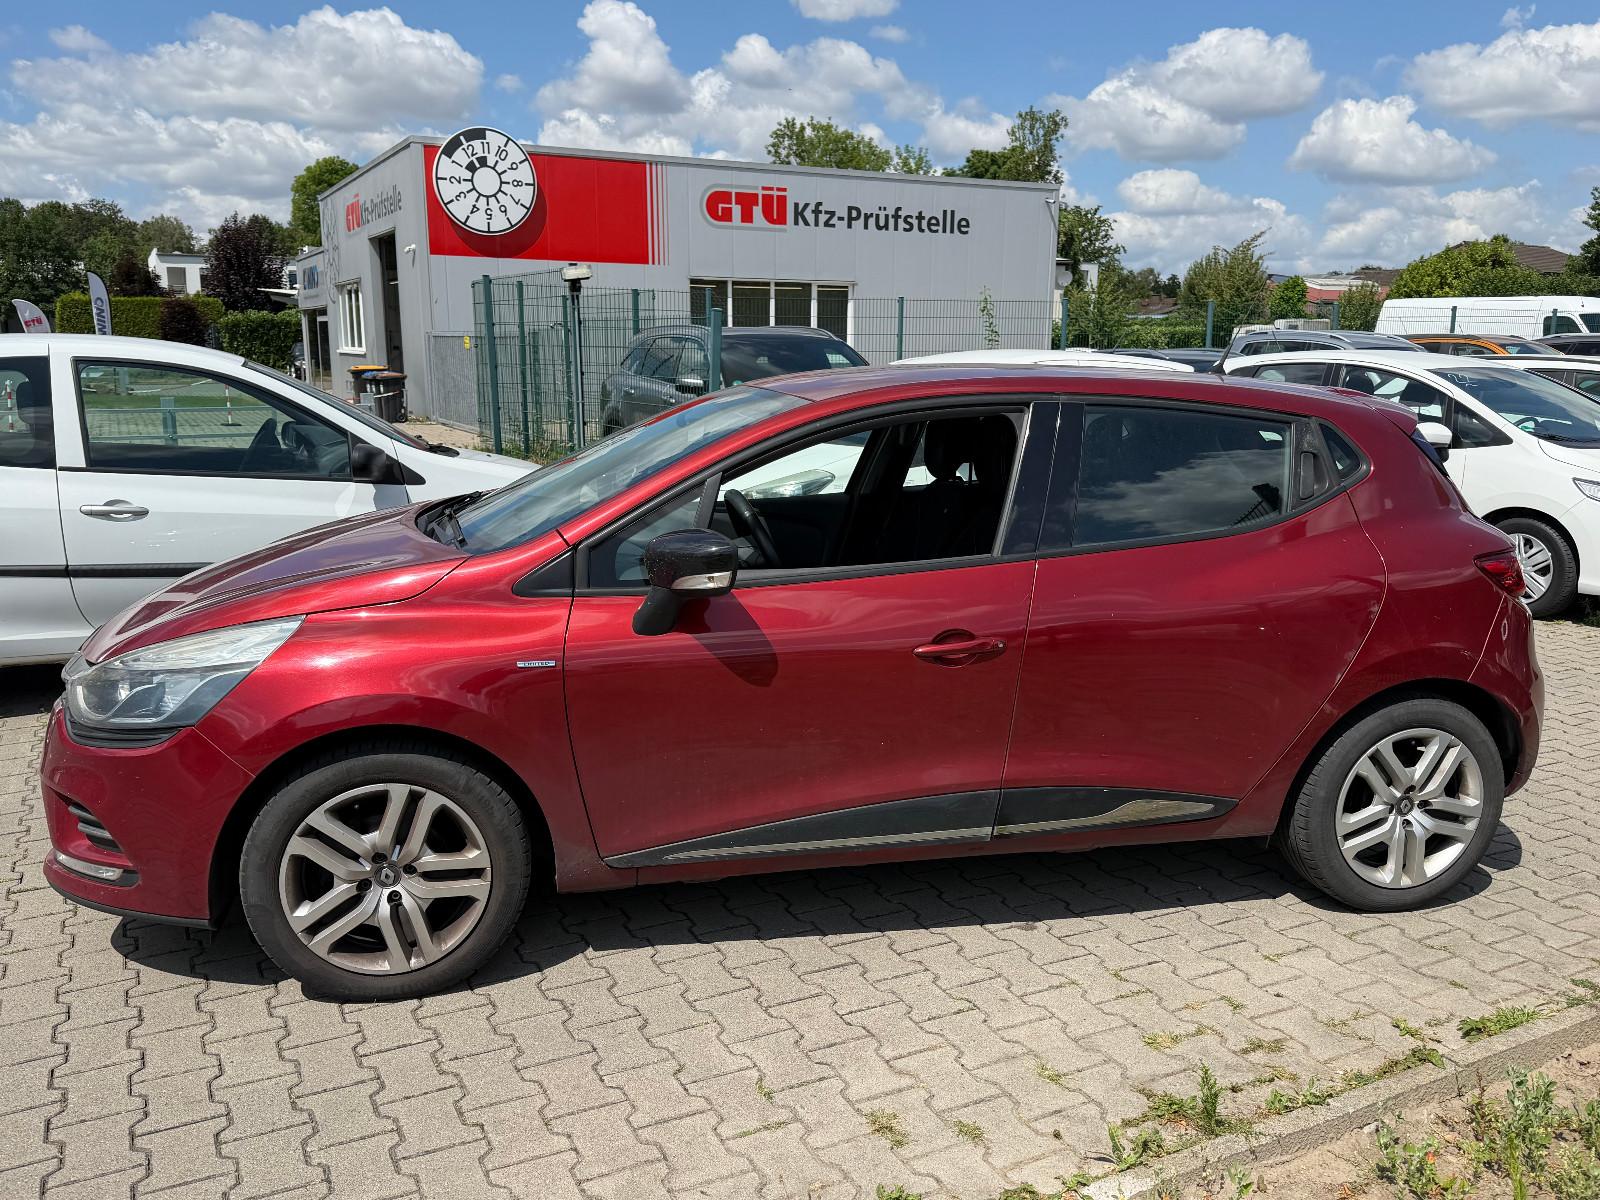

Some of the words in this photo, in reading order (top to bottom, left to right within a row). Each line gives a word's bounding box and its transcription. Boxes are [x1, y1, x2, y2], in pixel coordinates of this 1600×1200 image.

[461, 144, 478, 159] 12
[480, 141, 490, 155] 11
[494, 145, 508, 161] 10
[451, 159, 464, 168] 1
[507, 161, 519, 171] 9
[448, 175, 462, 185] 2
[511, 179, 524, 188] 8
[454, 191, 467, 202] 3
[509, 194, 521, 205] 7
[345, 193, 361, 233] GTÜ
[469, 203, 480, 215] 4
[484, 207, 493, 221] 5
[498, 204, 508, 217] 6
[705, 186, 788, 226] GTÜ
[793, 201, 971, 235] Kfz-Prüfstelle
